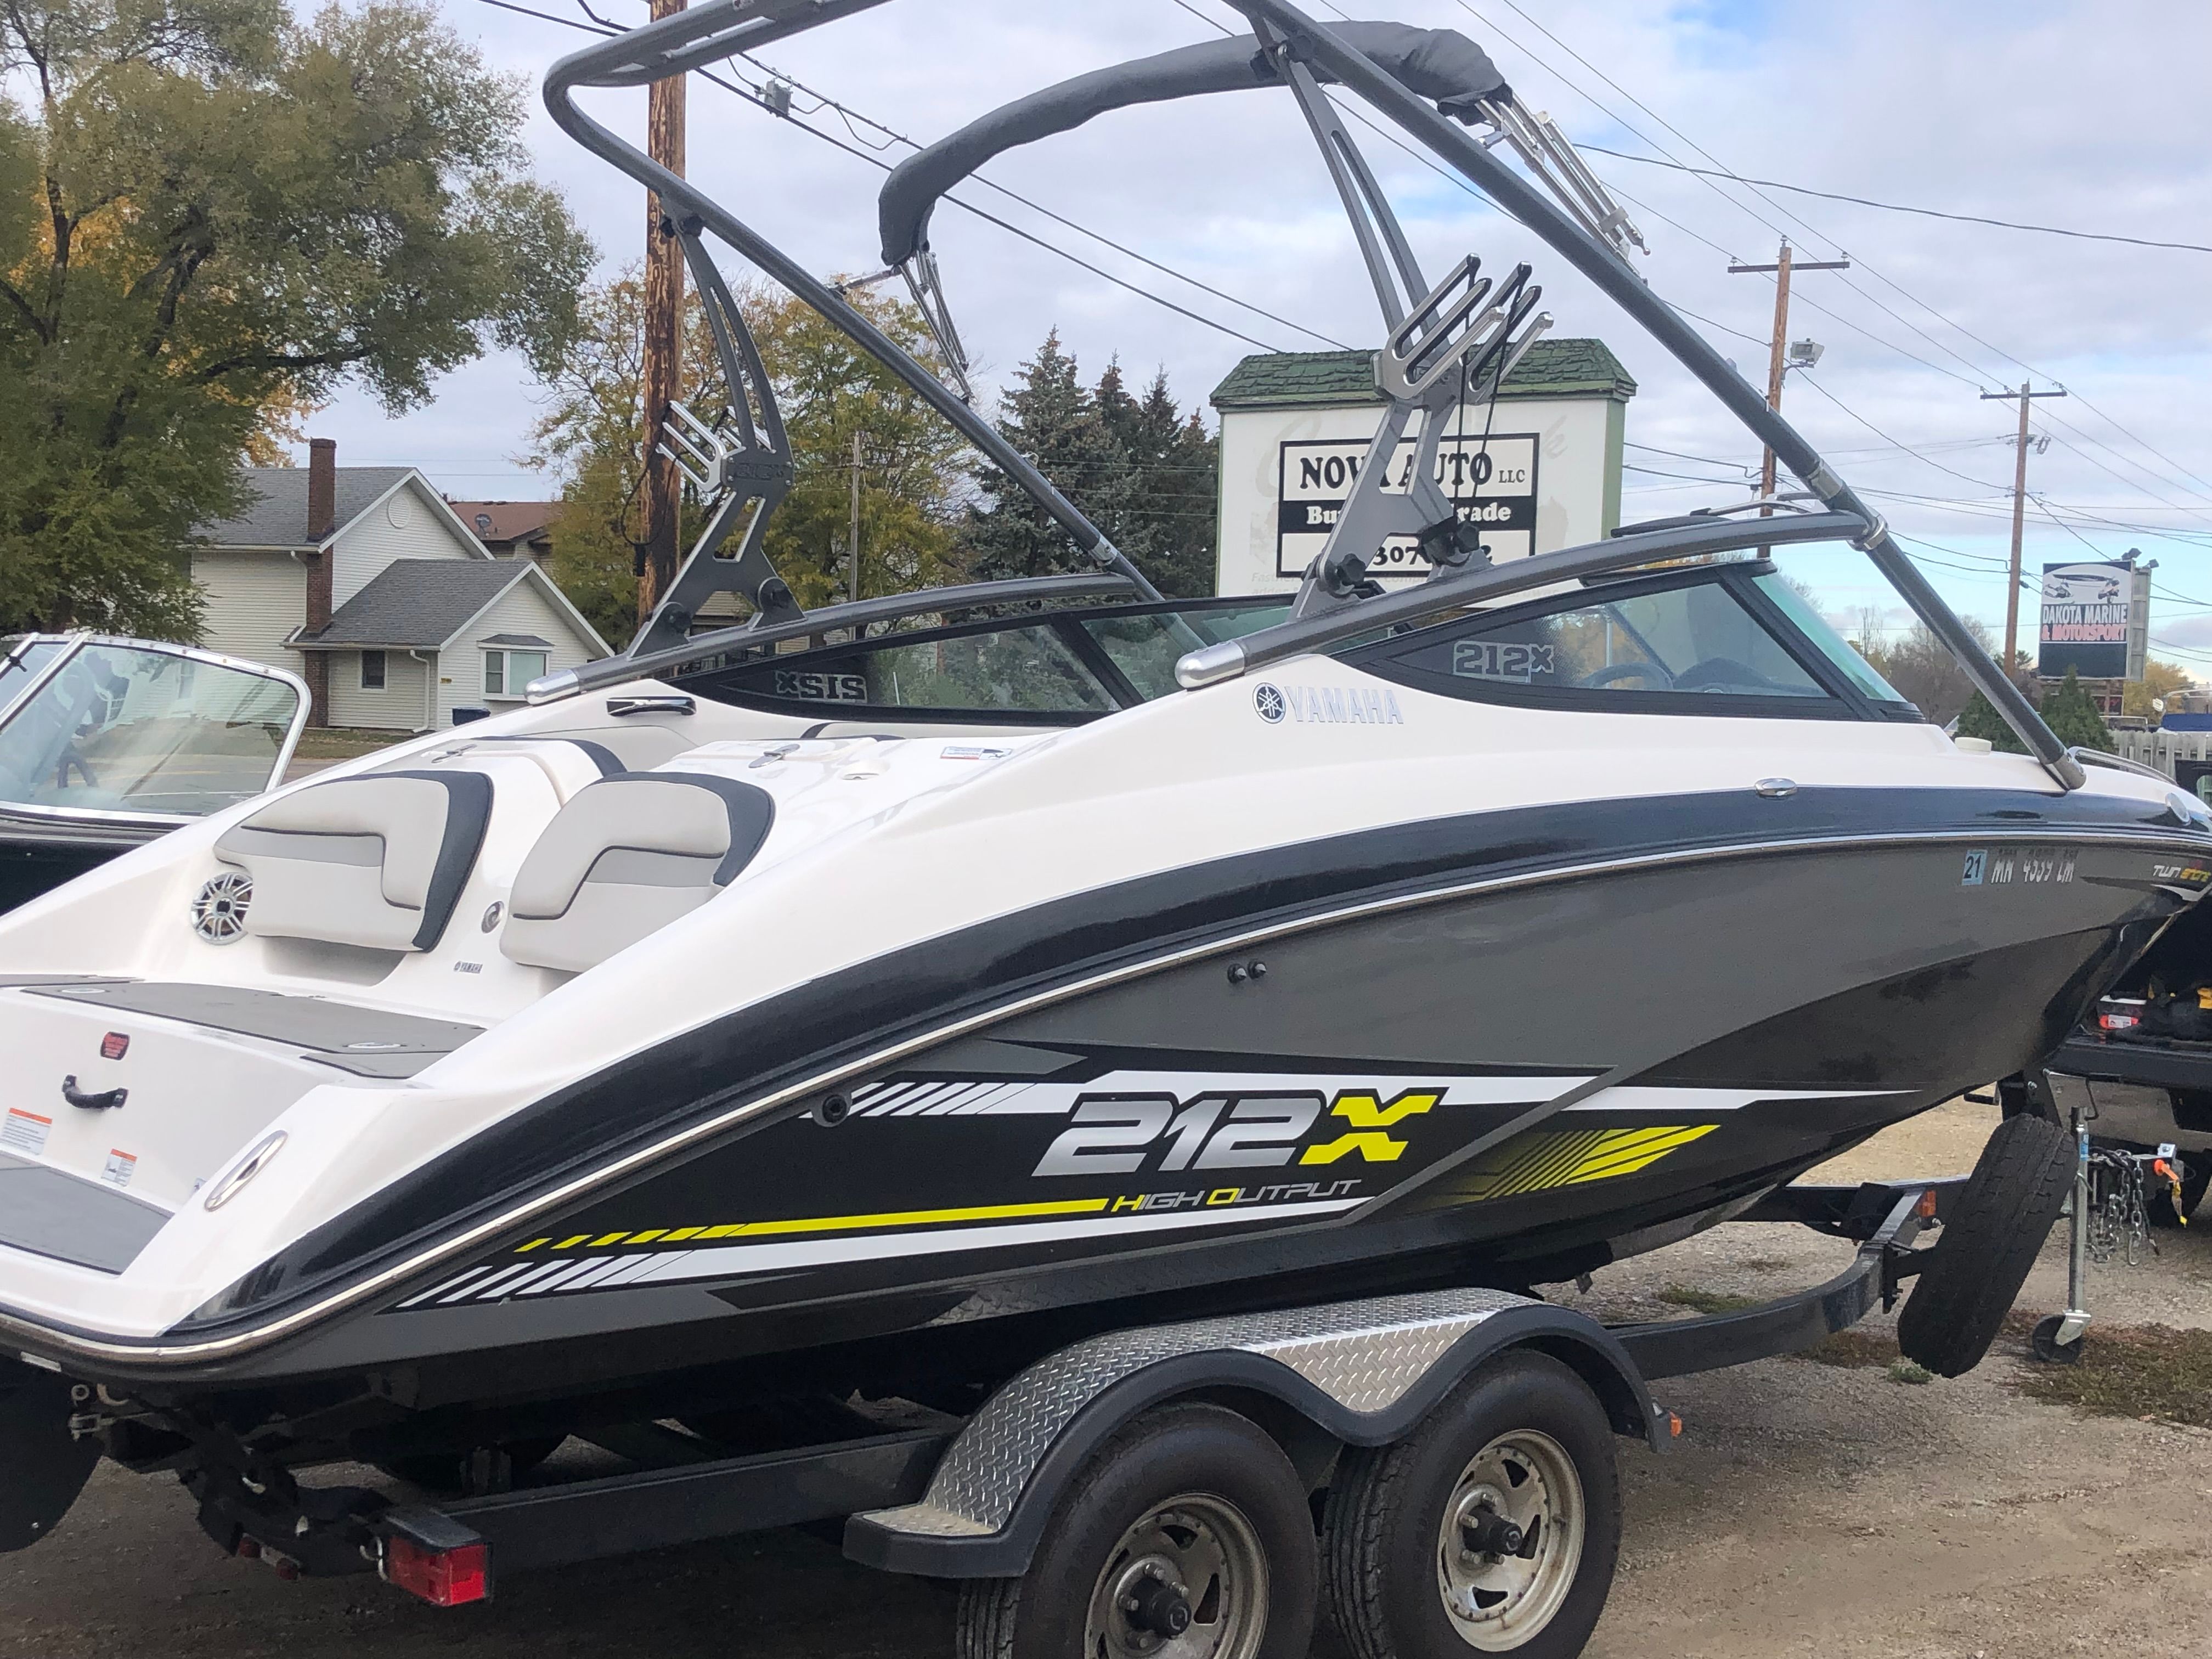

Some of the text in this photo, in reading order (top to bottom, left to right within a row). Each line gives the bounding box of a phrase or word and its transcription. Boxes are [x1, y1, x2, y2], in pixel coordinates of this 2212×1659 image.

[1498, 470, 1525, 483] LLC
[1307, 501, 1511, 525] Bu rade
[2043, 605, 2127, 624] DAKOTA MARINE
[2041, 623, 2127, 641] & MOTORSPORT
[1453, 641, 1554, 682] 212X
[1285, 686, 1403, 724] YAMAHA
[1964, 855, 1981, 878] 21
[1031, 1094, 1440, 1177] 212X
[1111, 1179, 1362, 1212] HIGH OUTPUT
